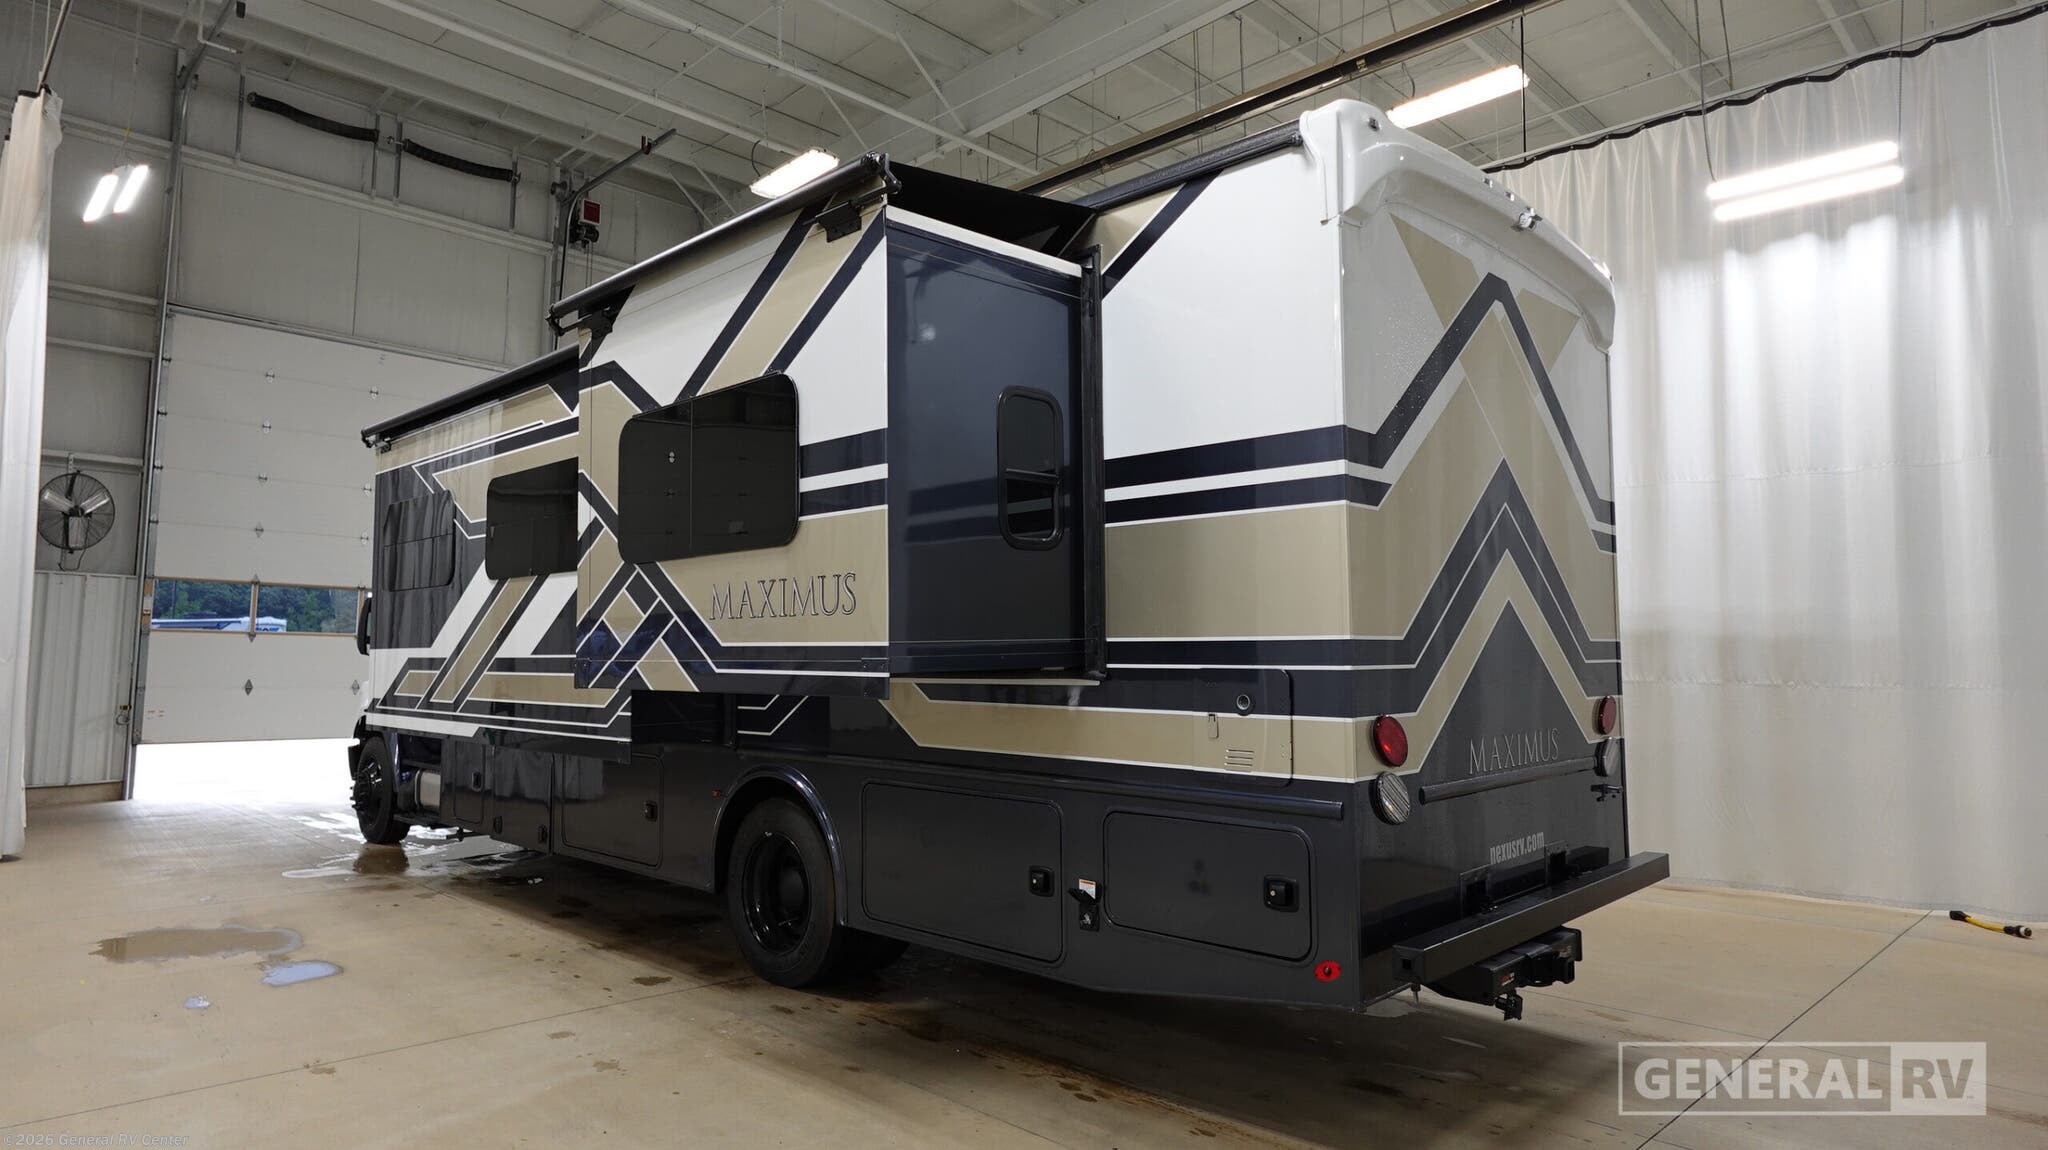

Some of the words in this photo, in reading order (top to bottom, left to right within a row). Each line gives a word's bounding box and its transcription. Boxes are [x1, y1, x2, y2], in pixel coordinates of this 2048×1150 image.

[709, 572, 857, 620] MAXIMUS
[1469, 727, 1560, 774] MAXIMUS
[1489, 831, 1545, 865] nexusrv.com
